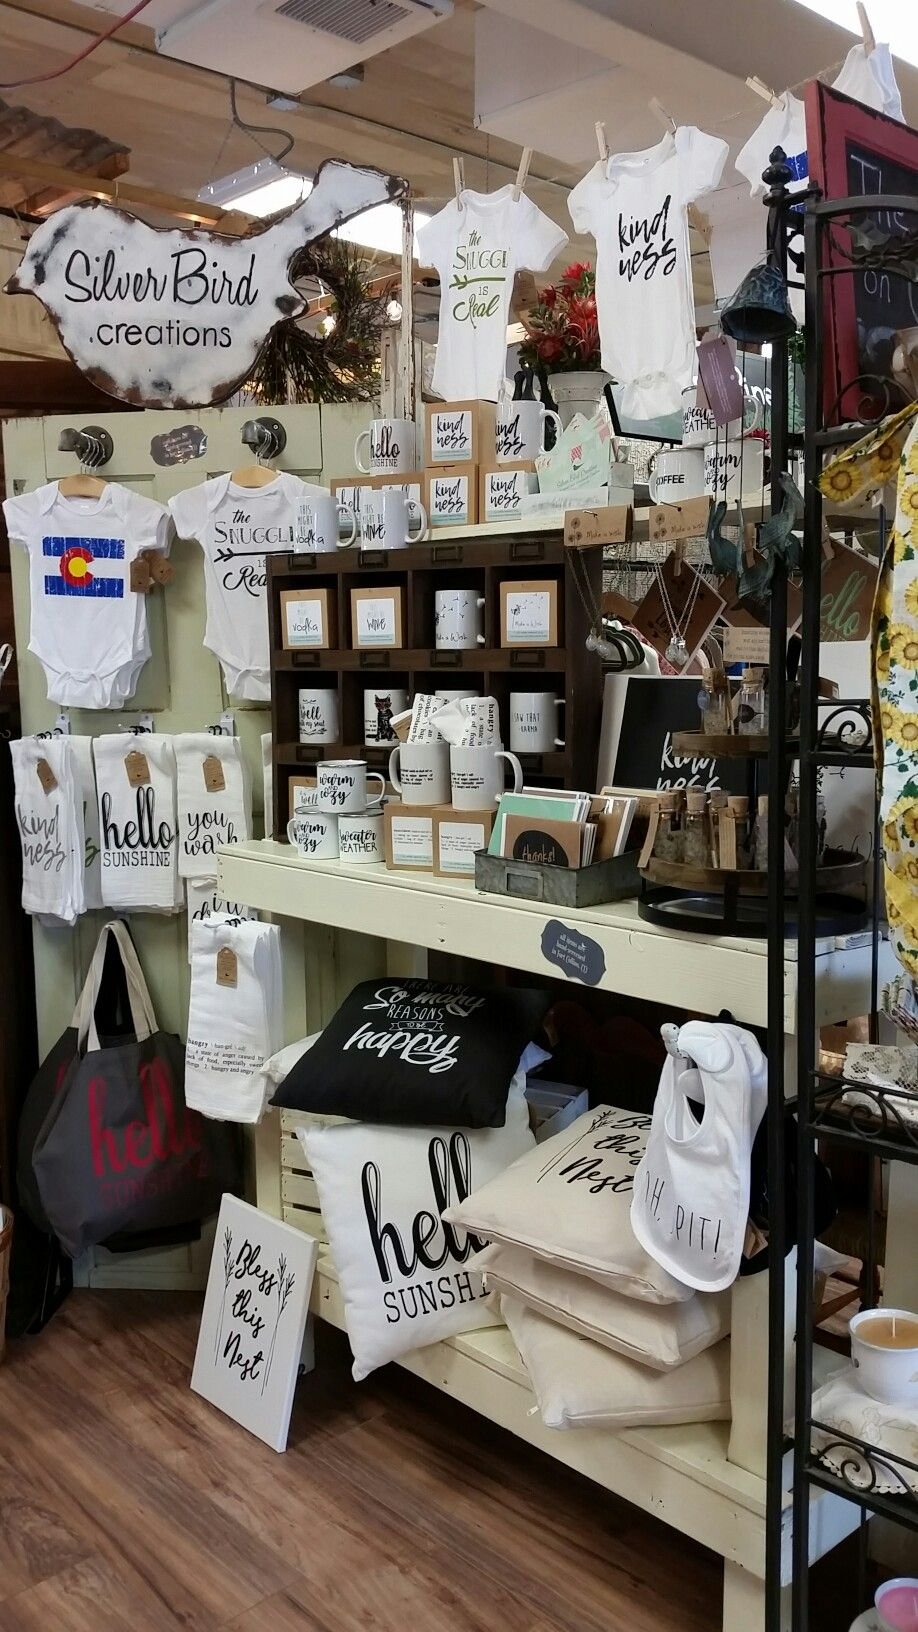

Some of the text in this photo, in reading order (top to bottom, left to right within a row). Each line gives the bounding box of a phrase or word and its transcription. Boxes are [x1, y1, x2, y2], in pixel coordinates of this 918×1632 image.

[469, 230, 481, 246] the
[618, 194, 671, 253] kind
[452, 246, 508, 270] SNUGGL
[619, 238, 677, 282] ness
[65, 248, 258, 306] Silver Bird
[97, 319, 232, 348] creations
[436, 413, 464, 433] kind
[495, 414, 520, 438] ind
[370, 425, 401, 459] hello
[436, 432, 469, 449] ness
[435, 478, 462, 499] kind
[490, 472, 518, 493] kind
[435, 497, 466, 514] ness
[490, 491, 522, 509] ness
[232, 509, 251, 523] the
[222, 565, 267, 598] Rea
[821, 560, 867, 637] ello
[487, 703, 495, 733] hangry
[320, 790, 351, 806] cozy
[18, 804, 59, 843] kind
[102, 786, 177, 850] hello
[188, 810, 228, 841] you
[23, 840, 67, 872] ness
[103, 850, 171, 867] SUNSHINE
[362, 986, 487, 1018] So many
[387, 1004, 446, 1021] REASONS
[188, 1038, 209, 1049] hangry
[342, 1022, 462, 1074] happy
[559, 1156, 633, 1194] Nest
[361, 1131, 492, 1285] hell
[234, 1239, 278, 1296] Bless
[383, 1271, 491, 1324] SUNSHI
[231, 1288, 266, 1339] this
[223, 1331, 265, 1382] Nest
